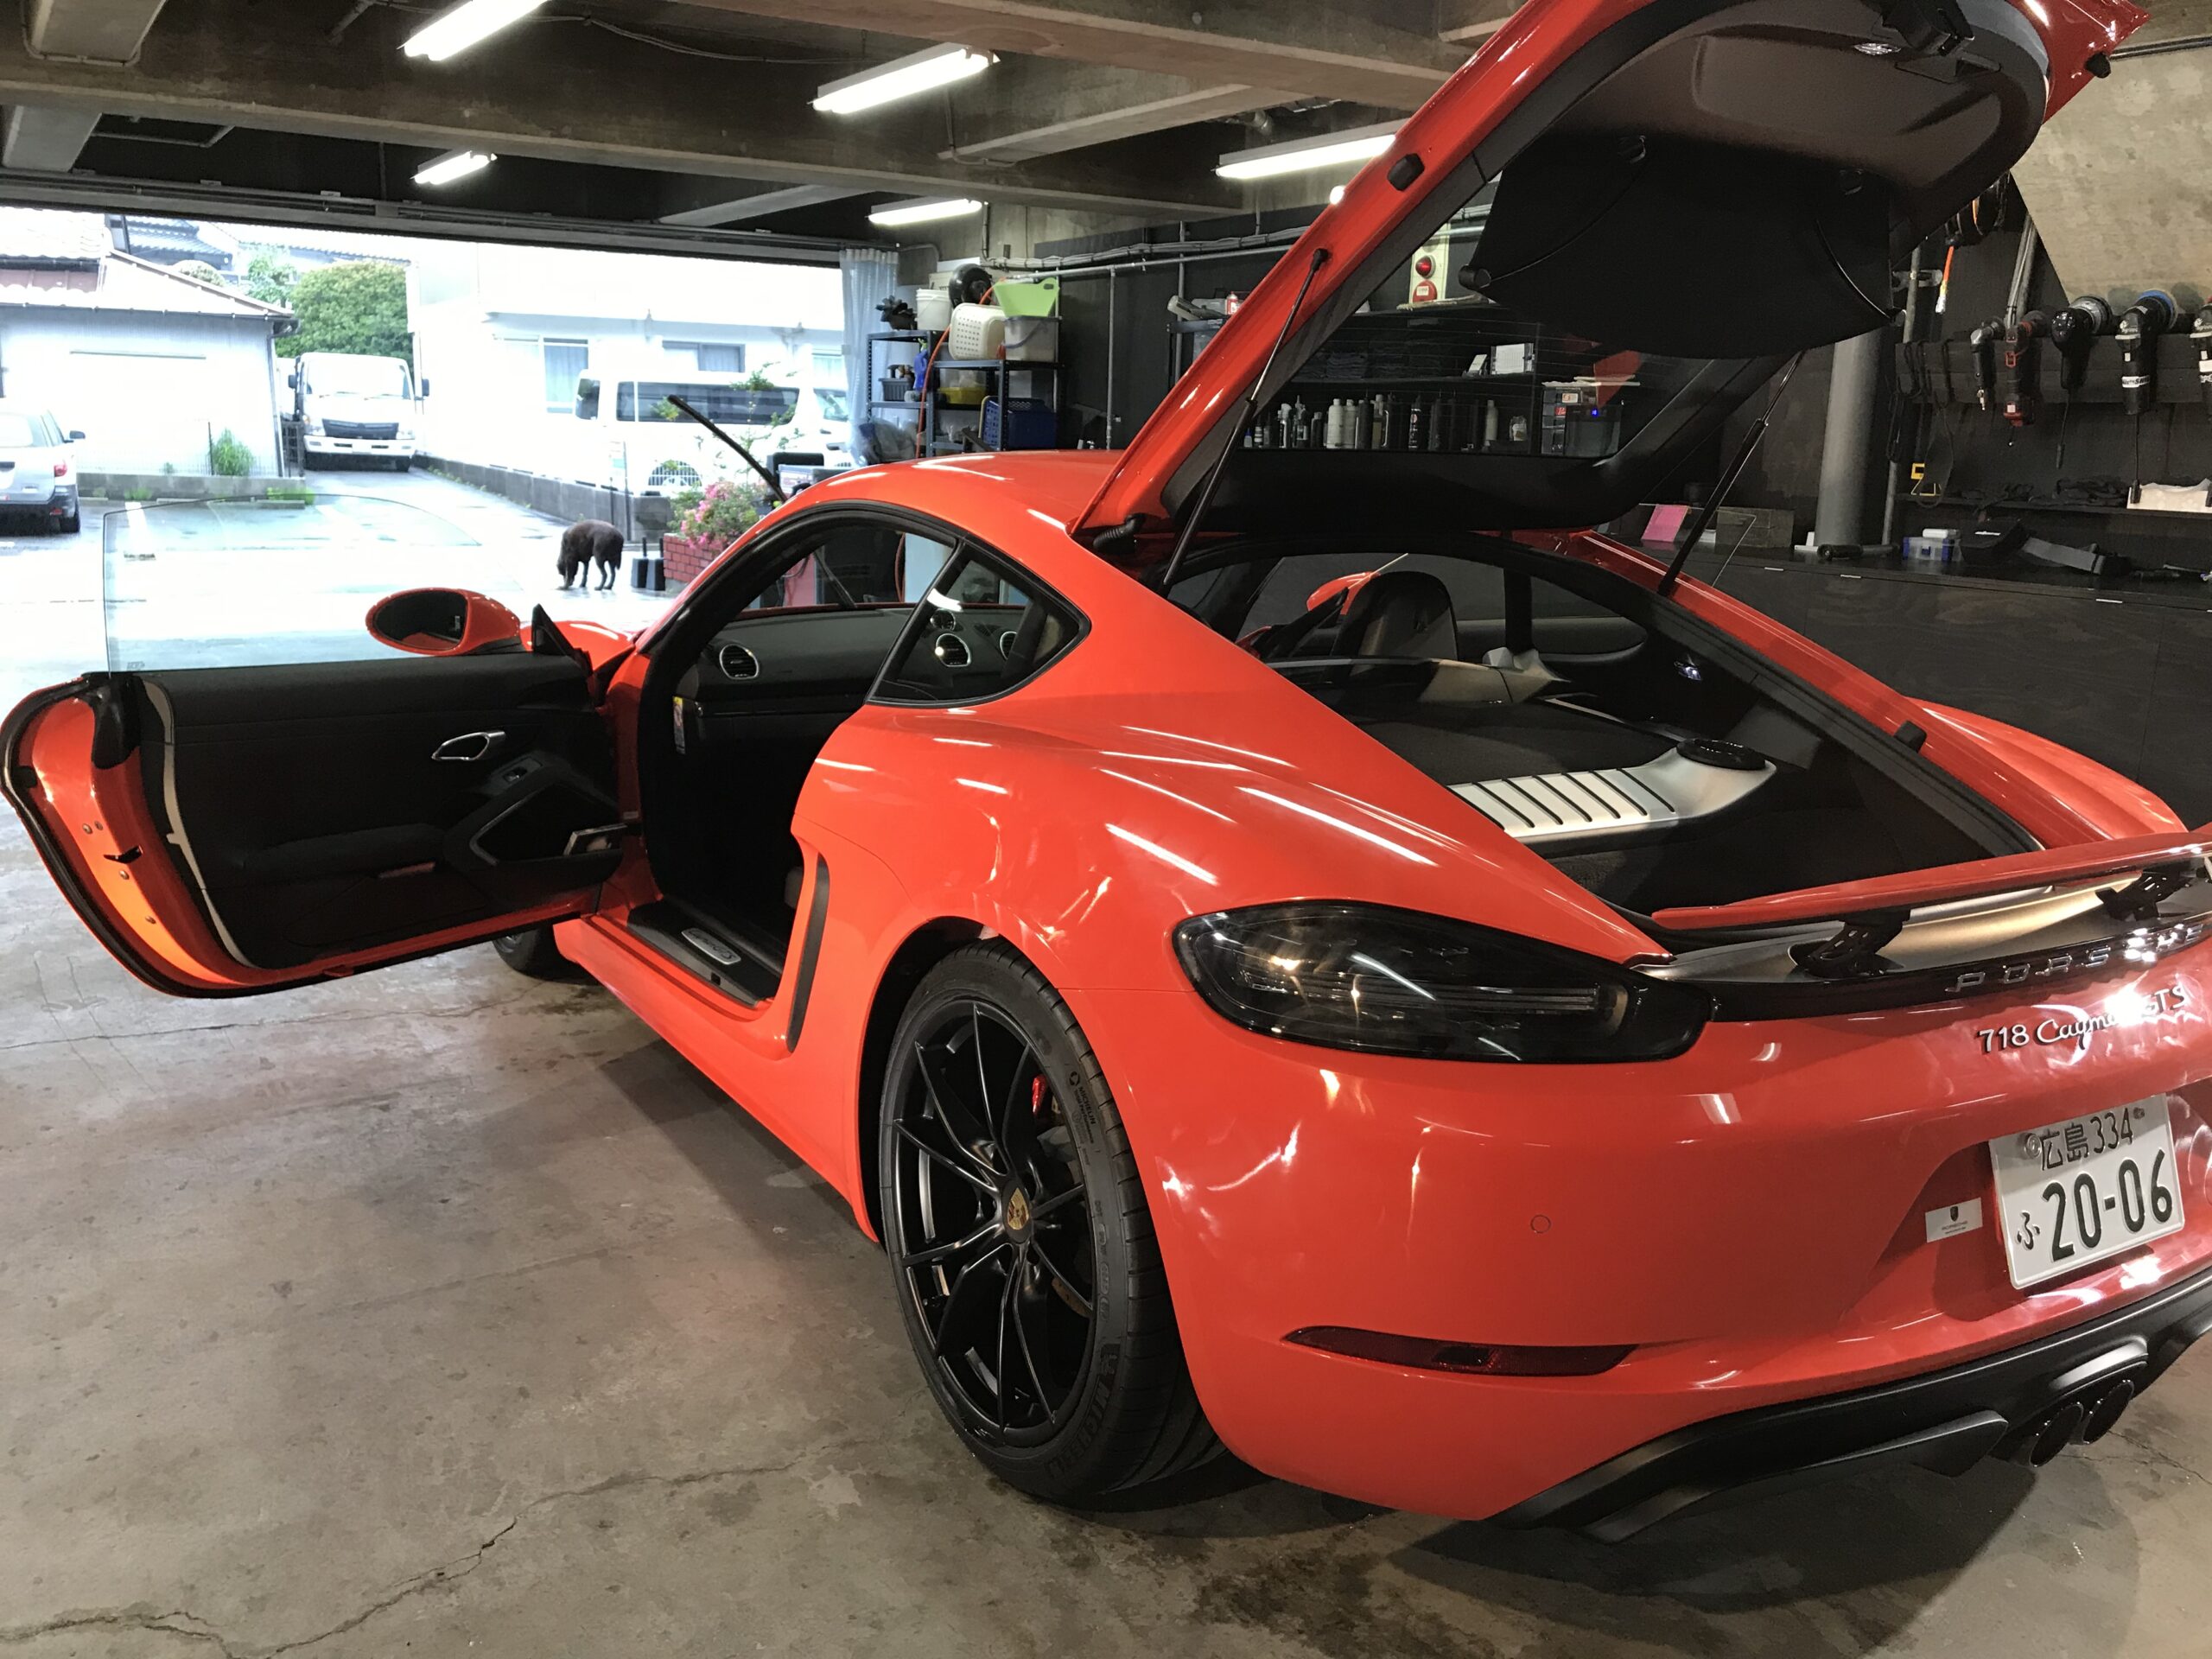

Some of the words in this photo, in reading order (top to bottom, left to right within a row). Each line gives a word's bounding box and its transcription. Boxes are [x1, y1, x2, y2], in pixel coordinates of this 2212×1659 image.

[1979, 1024, 2030, 1052] 718
[2036, 1009, 2131, 1050] Cayma
[2017, 1211, 2040, 1251] ふ
[2042, 1148, 2173, 1262] 20-06
